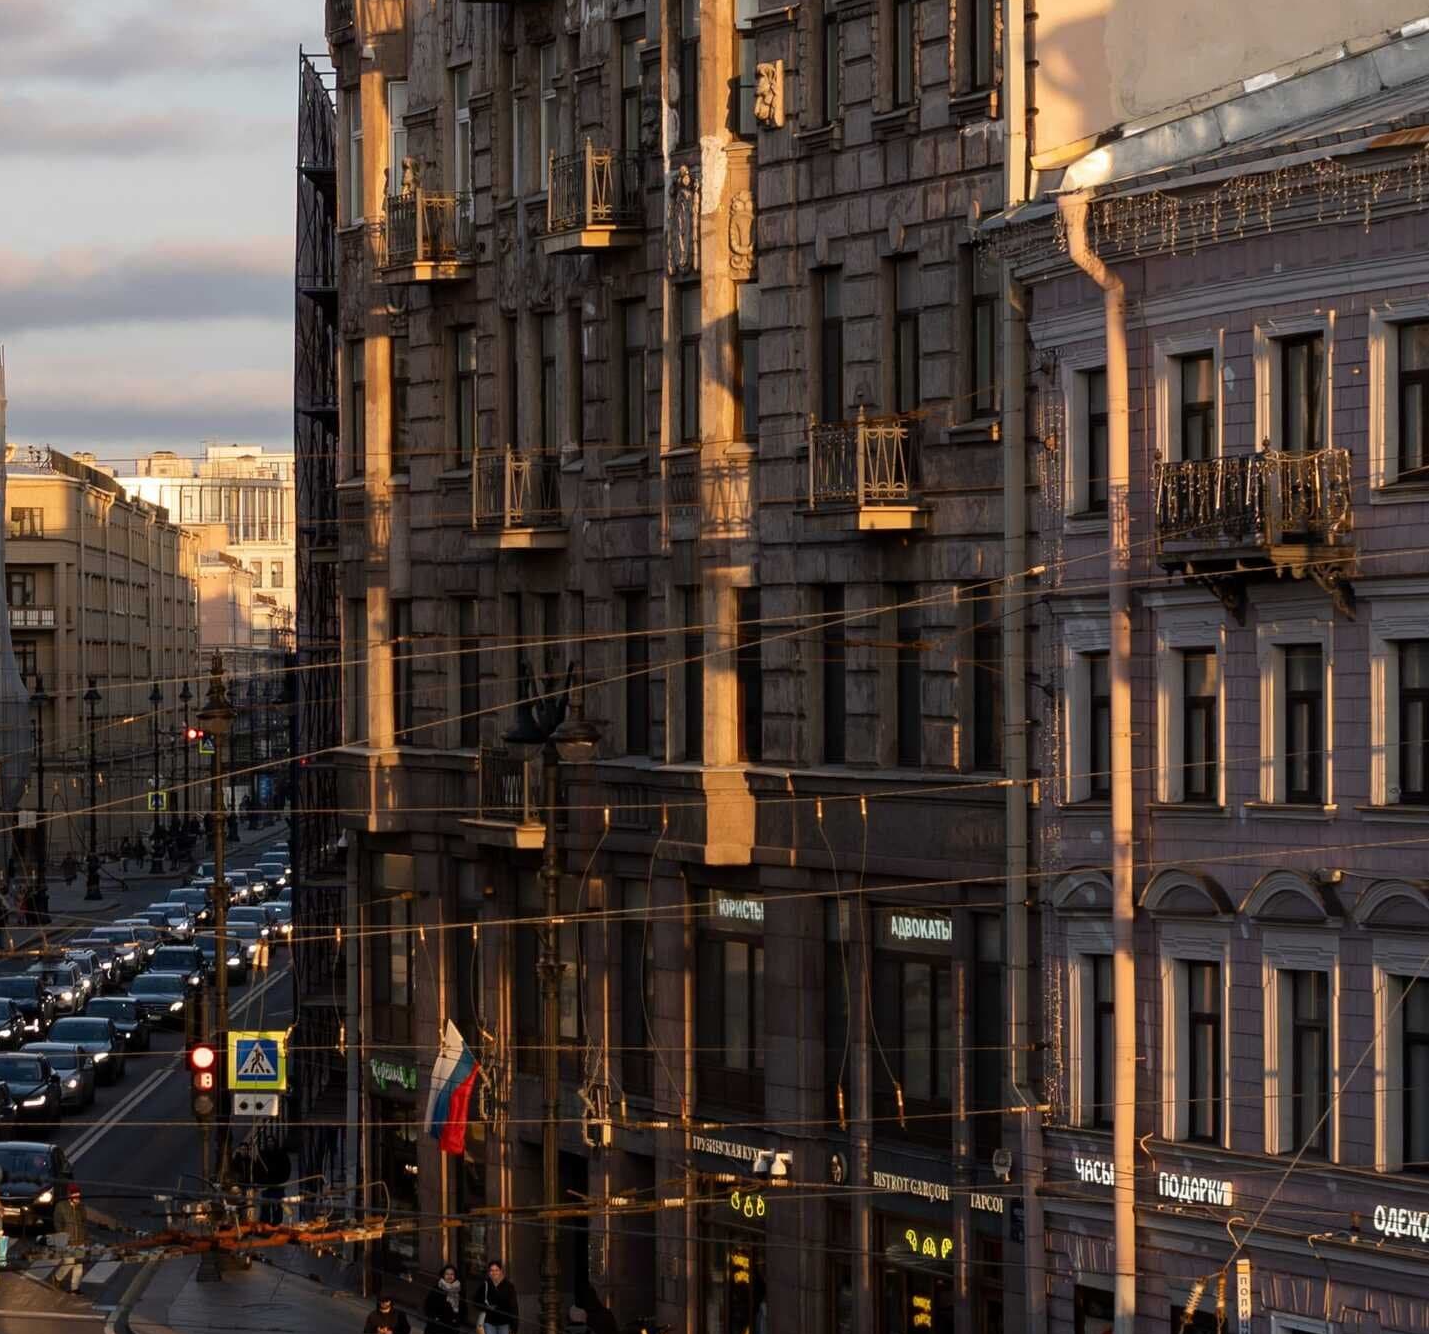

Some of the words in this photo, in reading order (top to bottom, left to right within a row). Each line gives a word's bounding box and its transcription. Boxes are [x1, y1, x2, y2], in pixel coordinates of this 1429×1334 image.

[718, 898, 764, 920] ЮРИСТЫ
[890, 915, 953, 941] АДВОКАТЫ
[872, 1170, 909, 1193] BISTROT
[1074, 1157, 1115, 1186] ЧАСЫ
[1158, 1171, 1233, 1206] ПОДАРКИ
